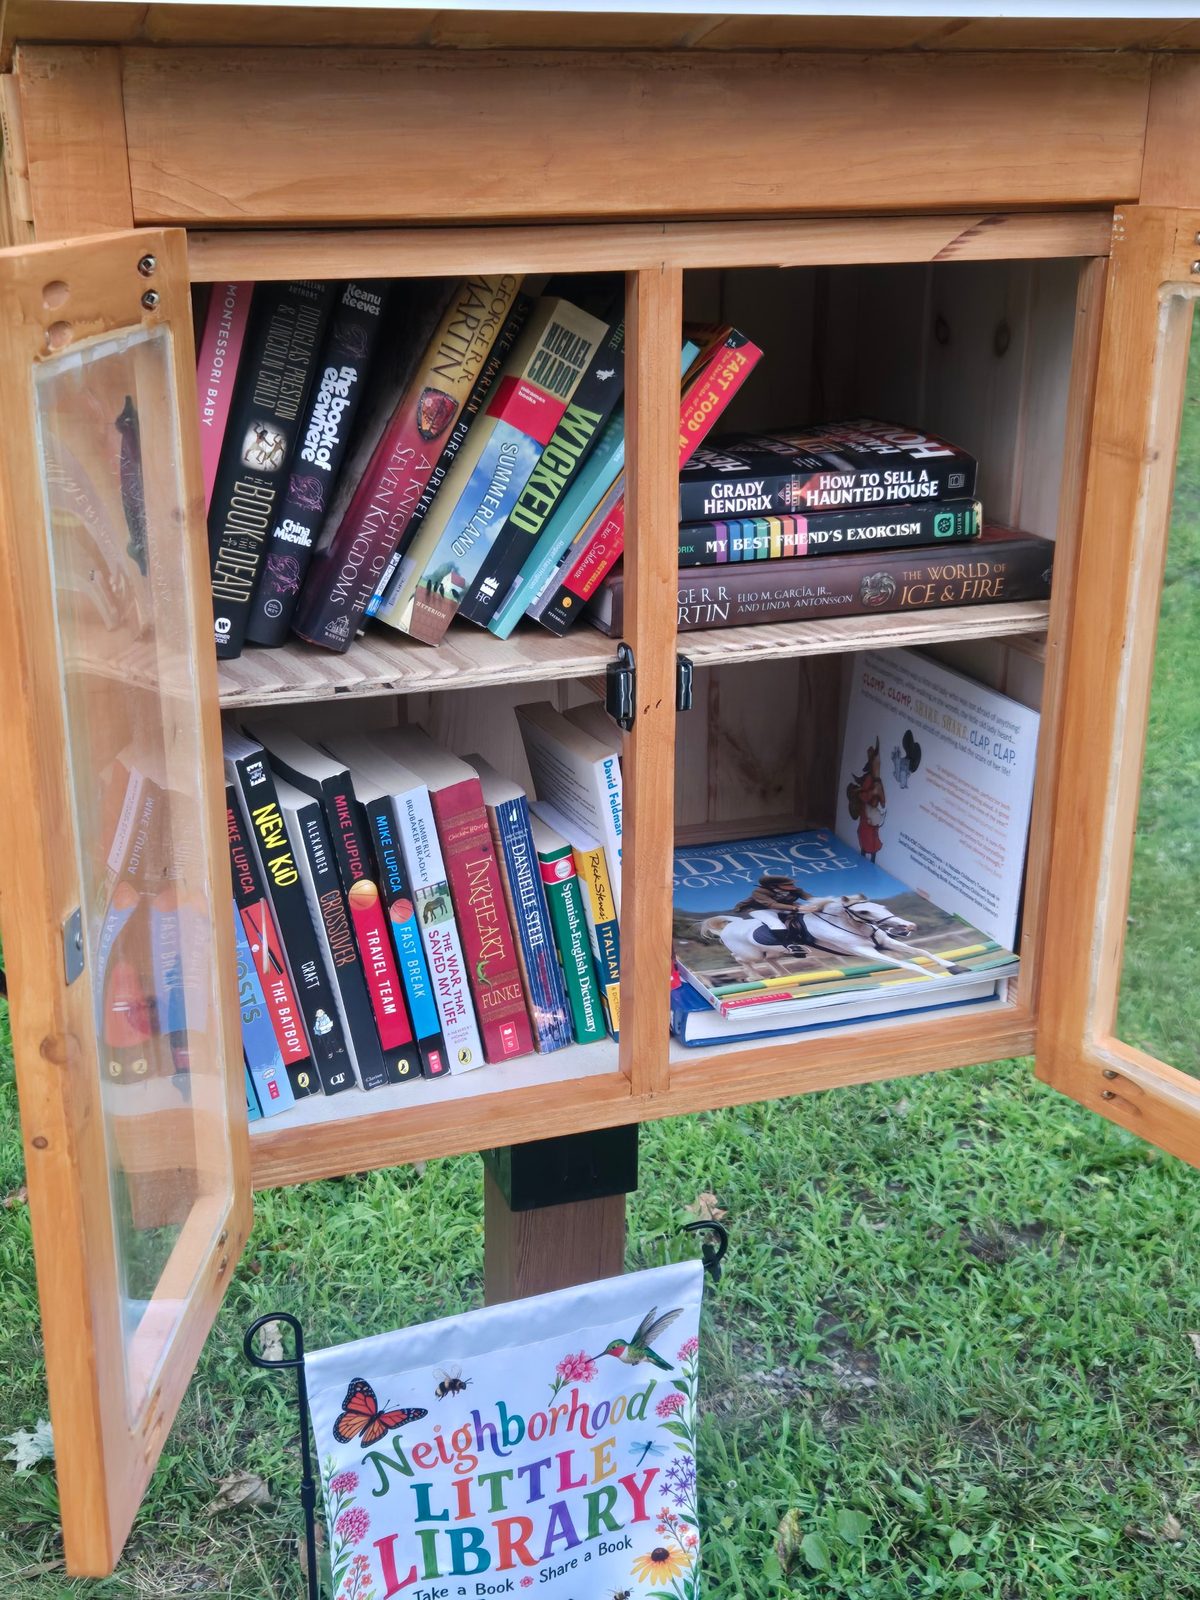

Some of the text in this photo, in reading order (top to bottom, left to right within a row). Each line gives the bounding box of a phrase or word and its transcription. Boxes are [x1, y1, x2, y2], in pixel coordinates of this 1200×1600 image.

[342, 292, 381, 316] Reeves
[347, 284, 382, 305] Keanu
[474, 274, 516, 349] GEORGE
[202, 285, 238, 426] MONTESSORI BABY
[262, 315, 295, 370] LINCOLN
[289, 304, 321, 366] DOUGLAS
[542, 322, 592, 370] MICHAEL
[253, 370, 281, 409] CHILD
[275, 365, 307, 421] PRESTON
[526, 349, 581, 398] CHABON
[717, 352, 747, 391] FAST
[301, 367, 338, 462] elsewhere
[314, 366, 358, 471] the book of
[411, 303, 528, 519] STEVE MARTIN PURE DRIVEL
[688, 391, 720, 431] FOOD
[375, 442, 416, 504] SEVEN
[415, 453, 431, 470] A
[509, 402, 603, 535] WICKED
[820, 469, 929, 490] HOW TO SELL A
[224, 481, 276, 541] BOOK
[381, 479, 424, 552] KNIGHT
[451, 442, 520, 558] SUMMERLAND
[704, 495, 772, 514] HENDRIX
[711, 481, 764, 499] GRADY
[806, 481, 939, 507] HAUNTED HOUSE
[282, 519, 311, 537] China
[329, 504, 390, 606] KINGDOMS
[678, 544, 694, 554] DRIX
[706, 522, 921, 553] MY BEST FRIEND'S EXORCISM
[212, 547, 260, 602] DEAD
[369, 555, 386, 577] OF
[901, 577, 1005, 605] ICE & FIRE
[903, 562, 1006, 581] THE WORLD OF
[352, 583, 375, 612] THE
[416, 601, 446, 618] HYPERION
[475, 591, 490, 605] HC
[678, 603, 730, 625] RTIN
[737, 594, 853, 615] AND LINDA ANTONSSON
[738, 592, 758, 603] ELIO
[760, 591, 773, 601] M.
[604, 759, 618, 790] David
[970, 730, 991, 755] CLAP,
[993, 743, 1016, 766] CLAP.
[252, 802, 288, 849] NEW
[334, 795, 364, 880] MIKE LUPICA
[405, 799, 429, 883] BRUBAKER BRADLEY
[418, 818, 432, 859] KIMBERLY
[609, 792, 622, 836] Feldman
[226, 808, 255, 894] MIKE LUPICA
[306, 820, 329, 875] ALEXANDER
[376, 815, 402, 893] MIKE LUPICA
[674, 842, 837, 877] DING
[763, 857, 858, 878] CARE
[466, 855, 506, 960] INKHEART
[512, 842, 537, 910] DANIELLE
[525, 910, 544, 951] STEEL
[320, 889, 357, 967] CROSSOVER
[602, 926, 620, 979] ITALIAN
[301, 961, 320, 989] CRAFT
[366, 929, 397, 1015] TRAVEL TEAM
[400, 926, 426, 999] FAST BREAK
[428, 930, 458, 1027] SAVED MY LIFE
[441, 931, 466, 1016] THE WAR THAT
[561, 882, 589, 975] Spanish-English
[580, 976, 596, 1032] Dictionary
[237, 960, 262, 1024] OSTS
[271, 980, 302, 1053] THE BATBOY
[482, 984, 522, 1009] FUNKE
[362, 1379, 657, 1498] Neighborhood
[410, 1437, 617, 1522] LITTLE
[373, 1468, 661, 1598] LIBRARY
[413, 1535, 633, 1600] Take a Book Share a Book
